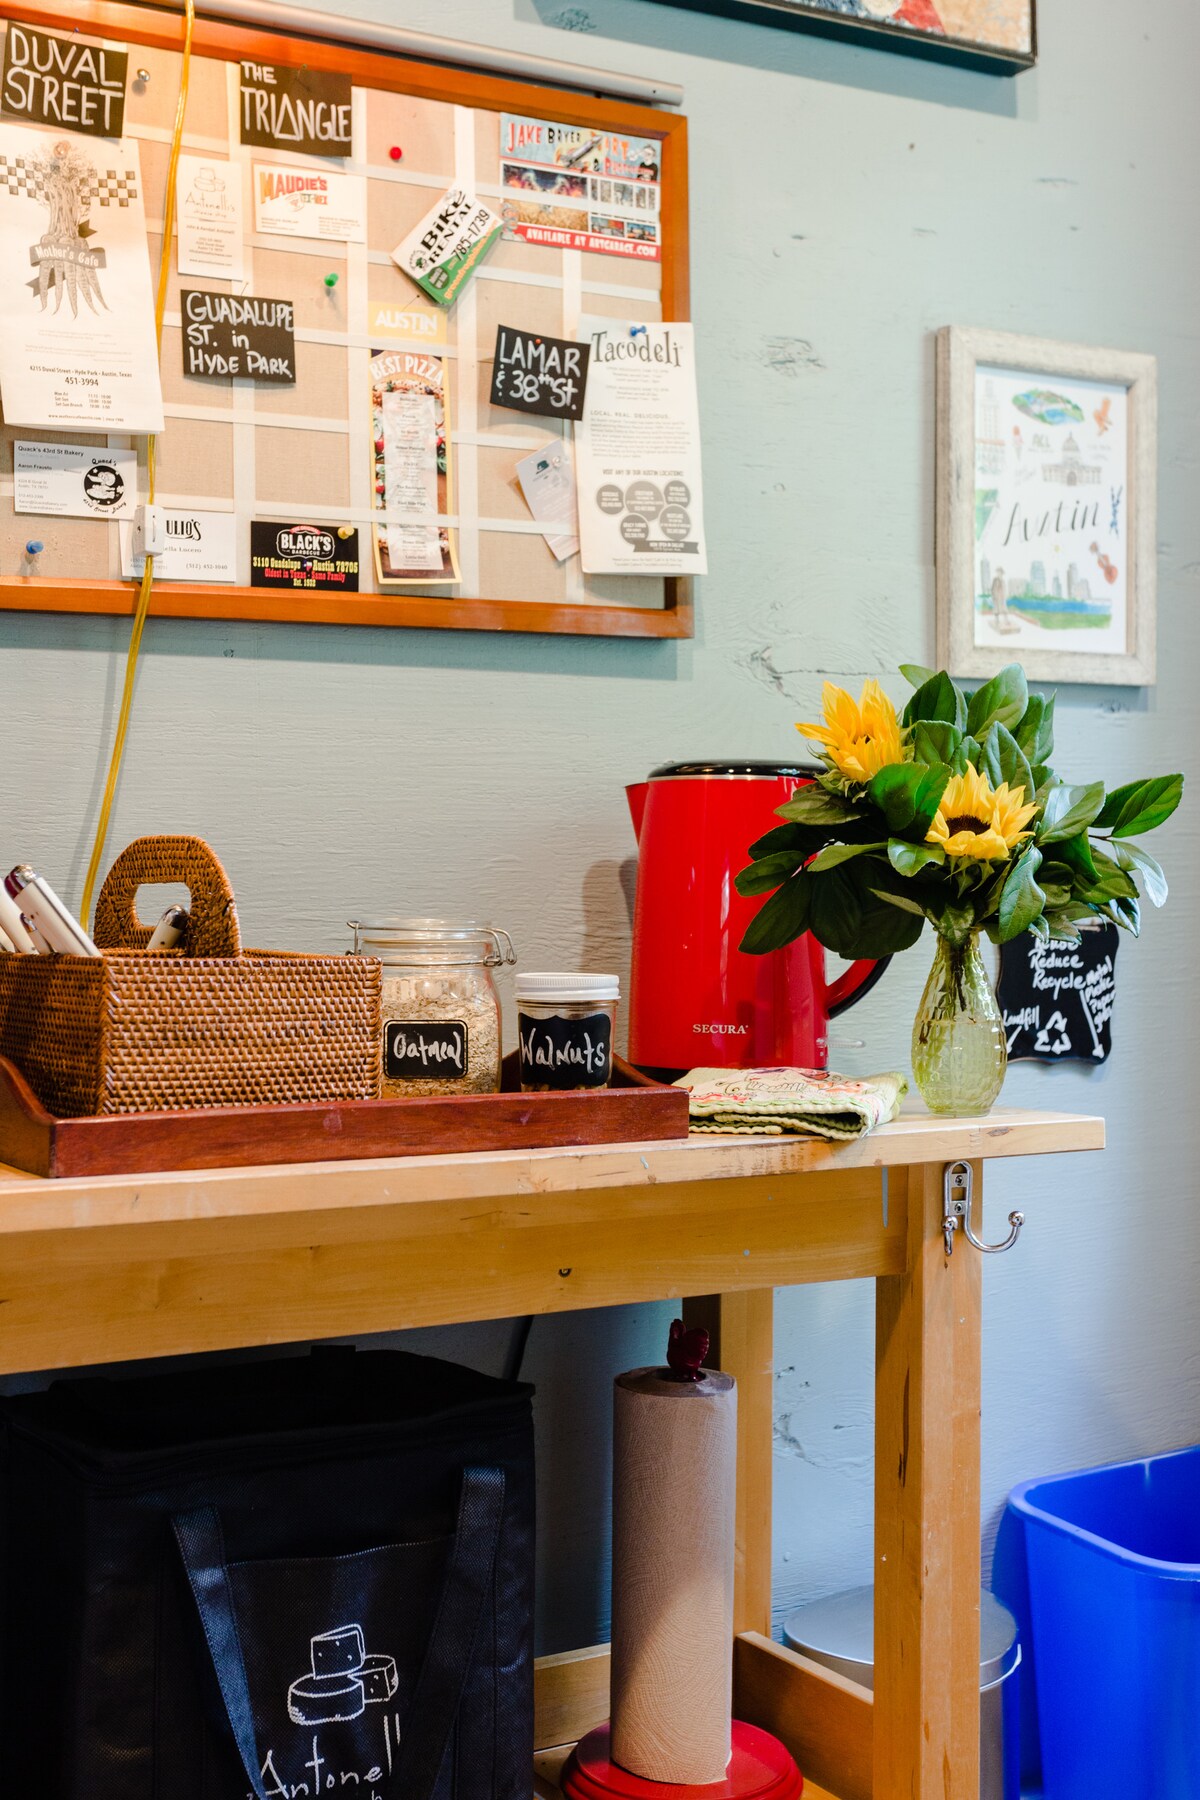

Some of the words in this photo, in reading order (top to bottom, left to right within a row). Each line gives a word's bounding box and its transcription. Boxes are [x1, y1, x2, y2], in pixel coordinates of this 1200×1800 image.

[11, 27, 123, 87] DUVAL
[241, 61, 277, 84] THE
[5, 66, 123, 130] STREET
[241, 87, 352, 141] TRIANGLE
[506, 123, 543, 153] JAKE
[548, 128, 580, 144] BRYER
[259, 171, 328, 204] MAUDIE'S
[421, 190, 466, 250] Bike
[429, 203, 475, 264] RENTAL
[451, 209, 490, 261] 785-1739
[35, 244, 76, 260] Mother's
[526, 227, 571, 245] AVAILABLE
[574, 235, 587, 247] AT
[186, 294, 295, 332] GUADALUPE
[375, 311, 437, 332] AUSTIN
[188, 323, 218, 348] ST.
[232, 329, 249, 350] in
[591, 330, 681, 367] Tacodeli
[190, 349, 239, 376] HYDE
[246, 350, 293, 378] PARK
[499, 332, 581, 377] LAMAR
[65, 376, 99, 386] 451-3994
[369, 355, 402, 380] BEST
[404, 355, 445, 385] PIZZA
[510, 369, 554, 403] 38th
[551, 377, 579, 410] St.
[166, 518, 202, 541] ULIO'S
[281, 533, 332, 551] BLACK'S
[253, 556, 269, 567] 3110
[270, 557, 301, 570] Guadalupe
[312, 560, 335, 572] Austin
[336, 561, 359, 574] 78705
[264, 568, 282, 578] Oldest
[283, 569, 289, 578] in
[290, 569, 307, 579] Texas
[311, 571, 326, 580] Same
[327, 572, 346, 583] Family
[293, 578, 303, 587] Est.
[1028, 948, 1084, 969] Reduce
[1032, 968, 1087, 1000] Recycle
[692, 1023, 747, 1035] SECURA
[1002, 1004, 1040, 1031] Landfill
[393, 1031, 463, 1069] Oatmeal
[520, 1027, 606, 1074] Walnuts
